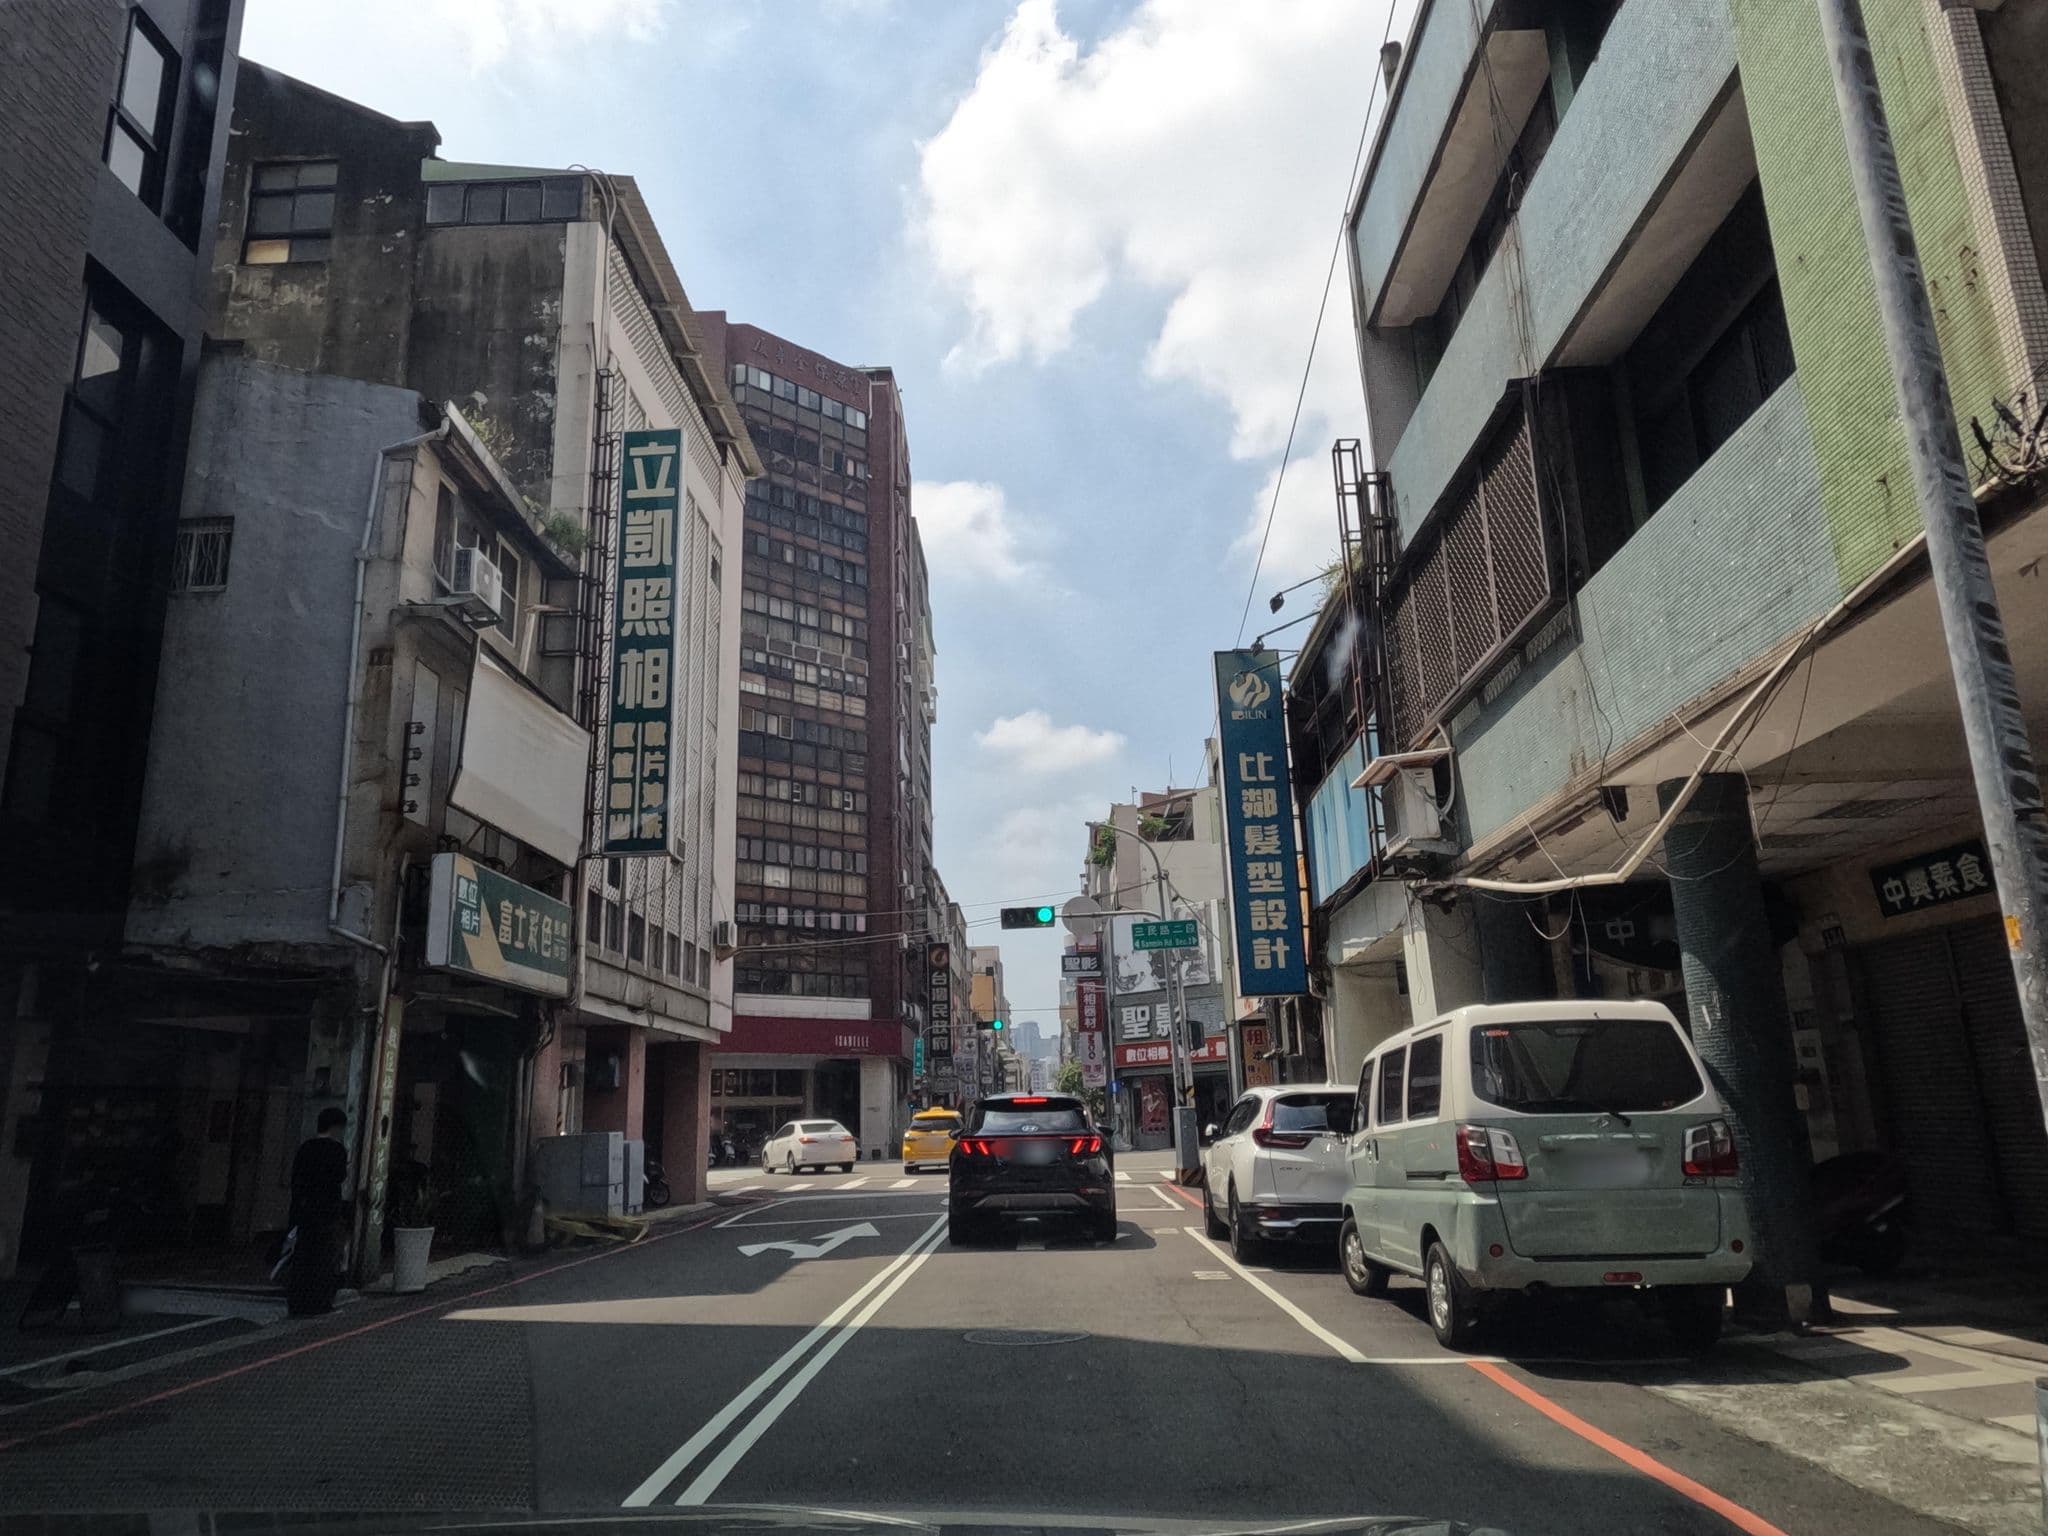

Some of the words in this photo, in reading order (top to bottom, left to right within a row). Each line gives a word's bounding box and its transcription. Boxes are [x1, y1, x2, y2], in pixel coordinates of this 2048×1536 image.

[617, 441, 677, 709] 立凱照相
[1238, 752, 1290, 970] 比鄰髮型設計
[1882, 852, 1989, 910] 中興素食
[499, 899, 553, 957] 富士彩色
[1134, 923, 1195, 937] 三民路二段
[1064, 956, 1097, 971] 聖影
